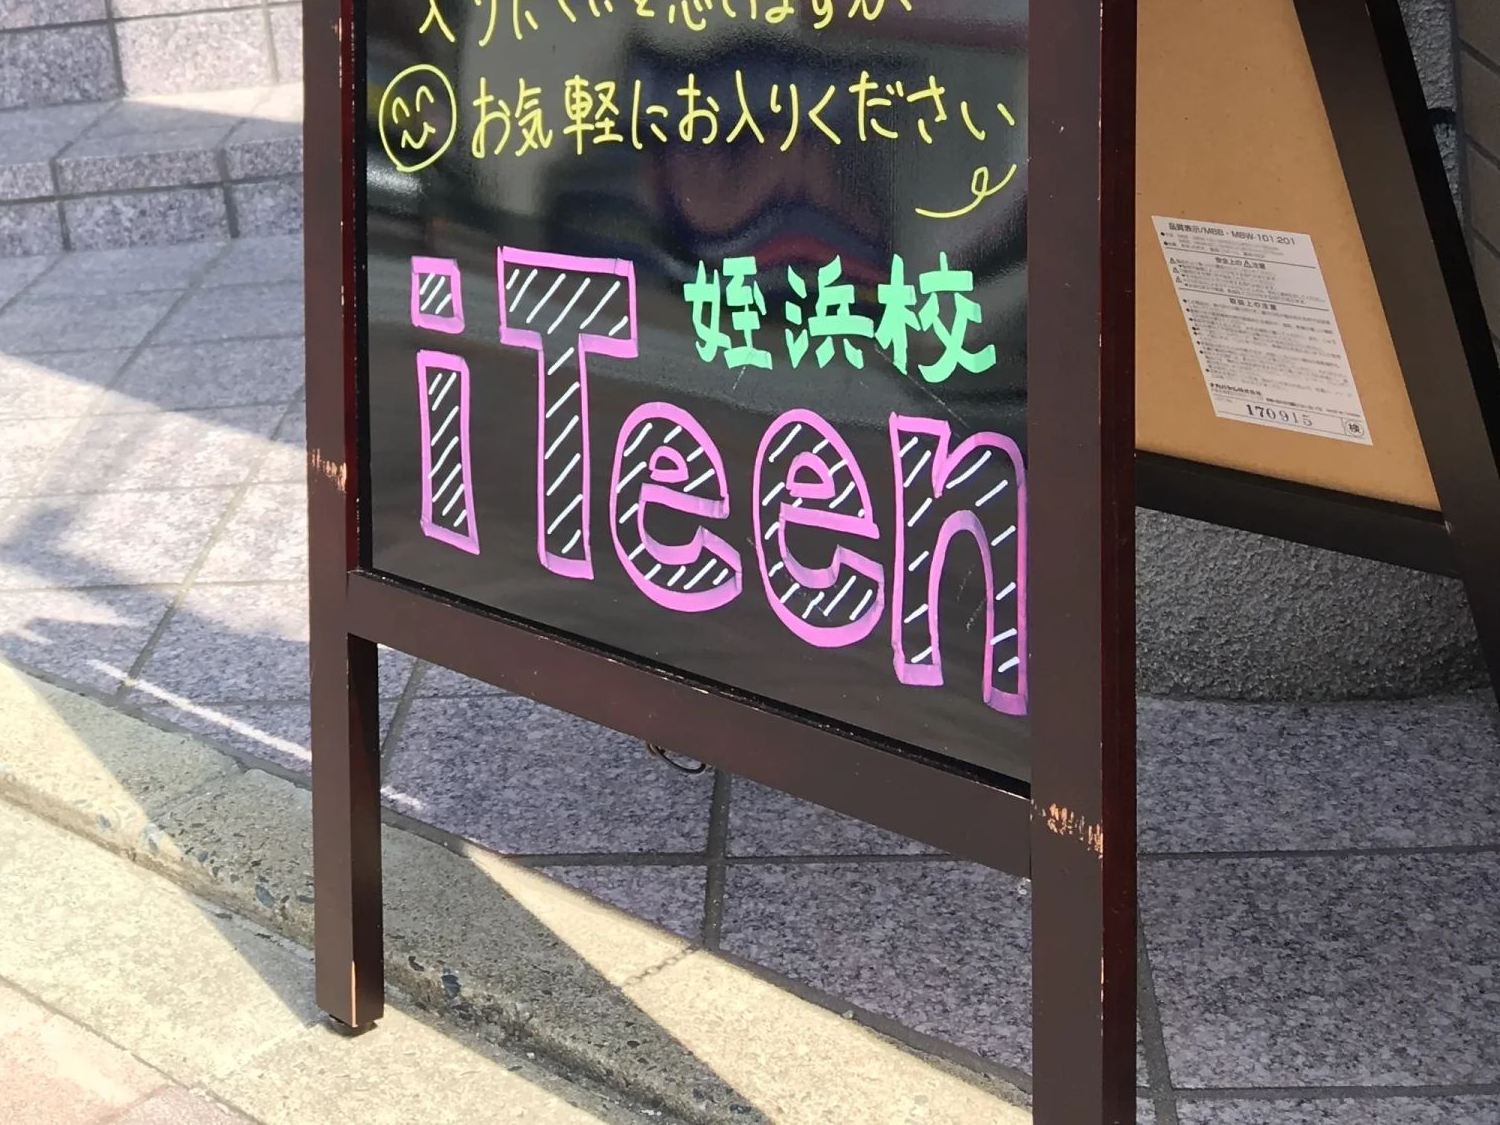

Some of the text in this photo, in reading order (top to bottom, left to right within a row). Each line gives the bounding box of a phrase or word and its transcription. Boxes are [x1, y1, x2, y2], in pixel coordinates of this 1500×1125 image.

[471, 70, 1015, 158] お気軽にお入りください
[683, 252, 997, 383] 姪浜校
[1246, 404, 1313, 427] 170915
[411, 246, 1029, 716] iTeen
